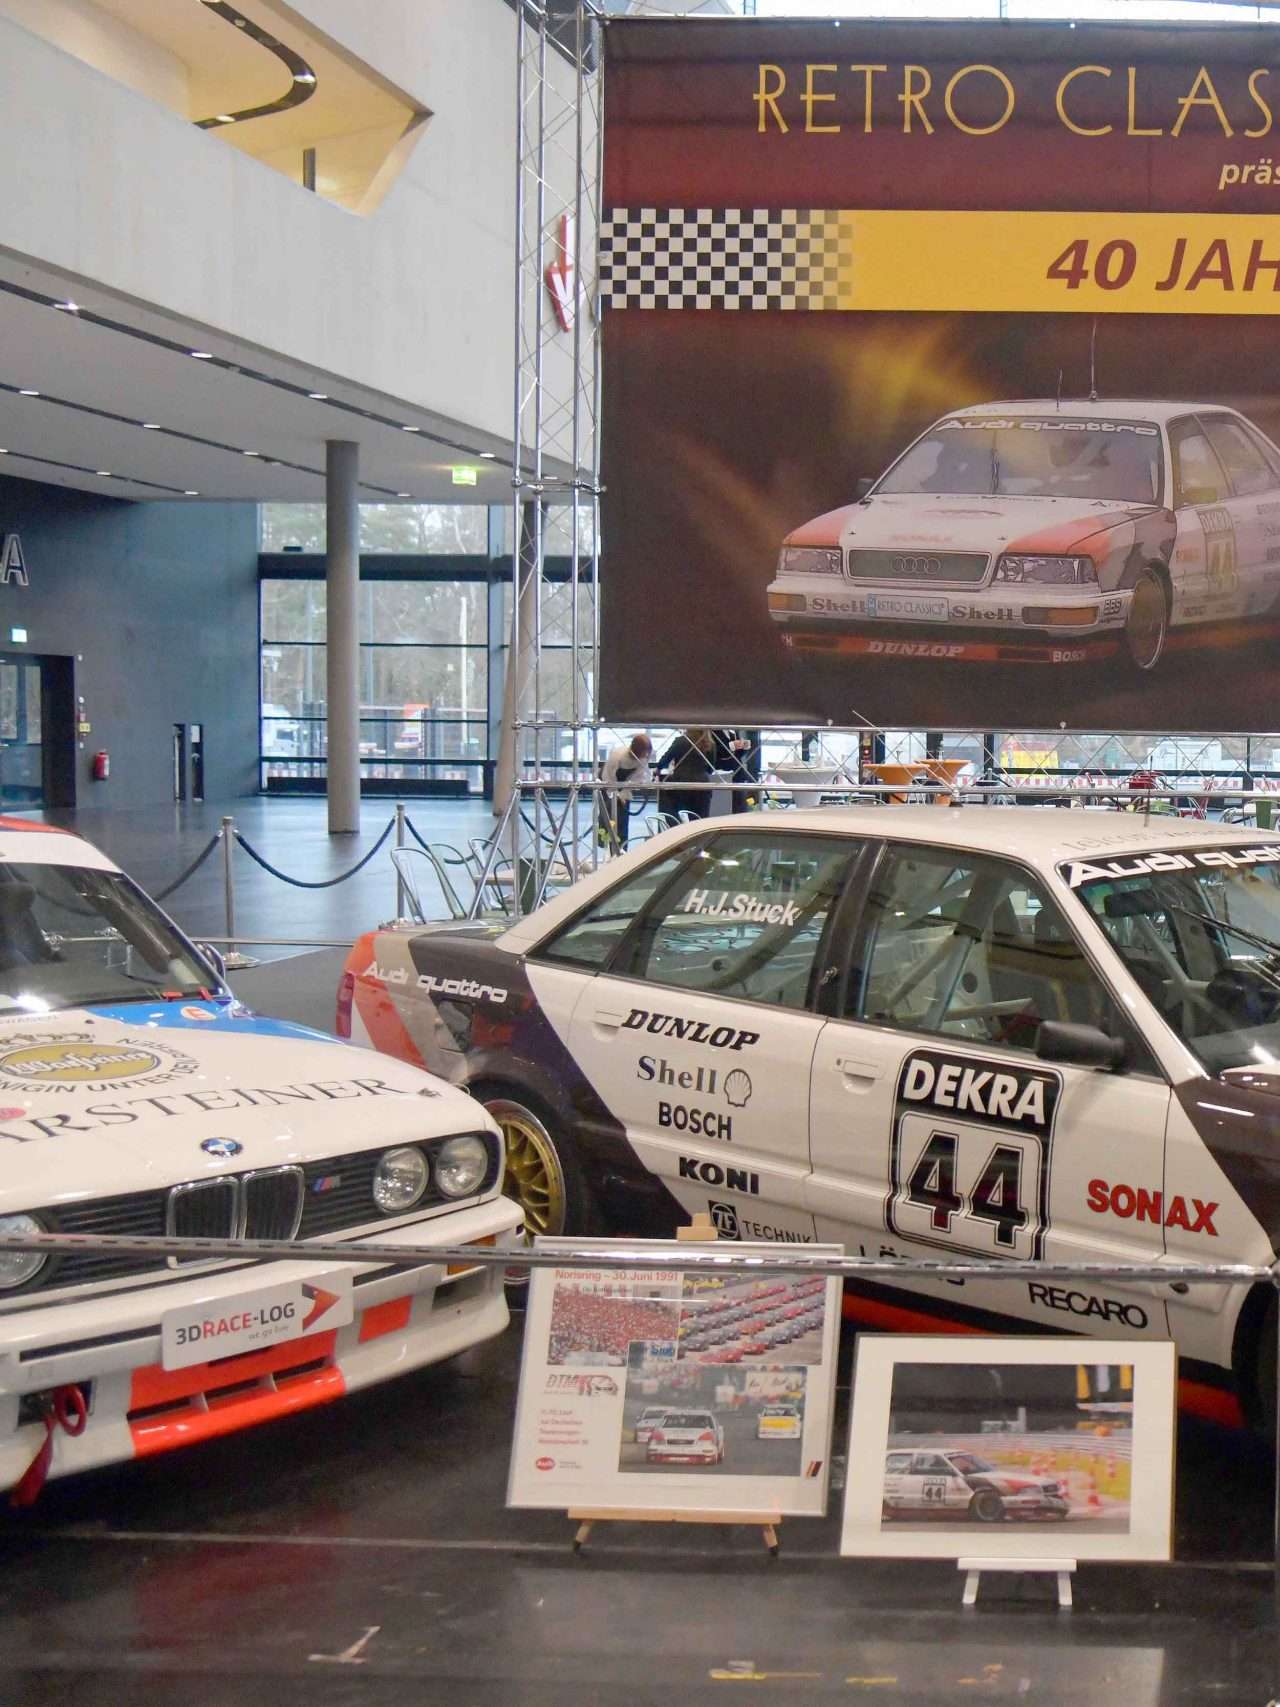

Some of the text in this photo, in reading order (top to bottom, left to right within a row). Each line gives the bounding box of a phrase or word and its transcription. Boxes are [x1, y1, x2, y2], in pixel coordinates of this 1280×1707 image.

[753, 63, 1015, 136] RETRO
[1046, 239, 1137, 291] 40
[935, 418, 1160, 437] Audi quattro
[811, 597, 865, 614] Shell
[952, 605, 1014, 622] Shell
[866, 640, 966, 658] DUNLOP
[1068, 852, 1197, 889] Audi
[683, 888, 801, 927] H.J.Stuck
[362, 960, 508, 1004] Audi quattro
[621, 1008, 761, 1052] DUNLOP
[636, 1054, 718, 1095] Shell
[902, 1058, 1047, 1125] DEKRA
[658, 1101, 733, 1141] BOSCH
[678, 1156, 761, 1196] KONI
[904, 1130, 1032, 1249] 44
[1086, 1178, 1220, 1237] SONAX
[175, 1302, 296, 1346] 3DRACE-LOG
[1027, 1282, 1149, 1330] RECARO
